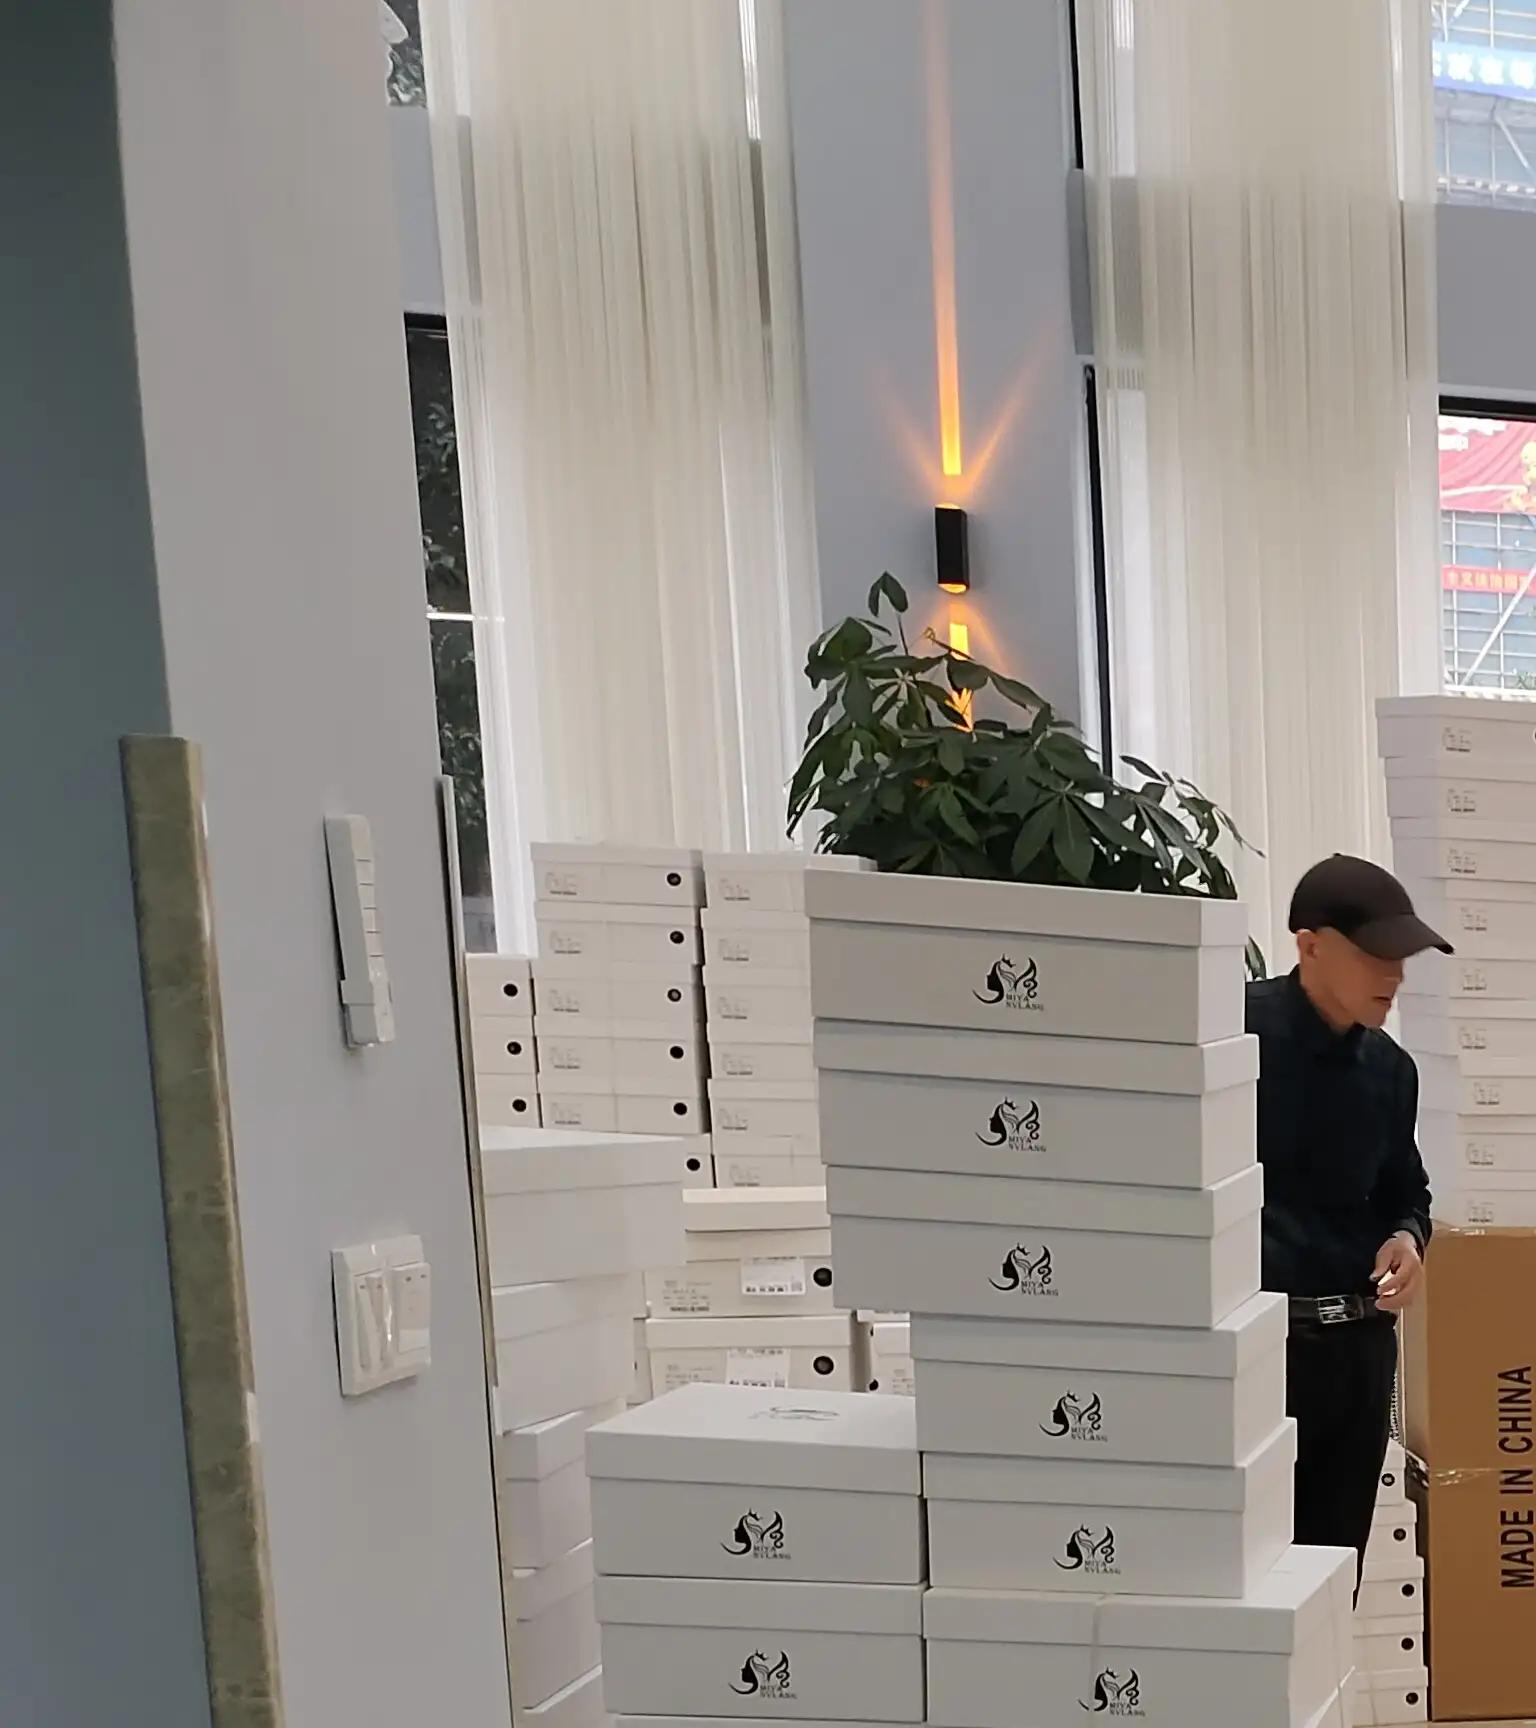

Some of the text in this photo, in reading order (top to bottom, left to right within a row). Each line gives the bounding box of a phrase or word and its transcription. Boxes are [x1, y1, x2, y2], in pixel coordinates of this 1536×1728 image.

[1497, 1366, 1535, 1588] MADE IN CHINA
